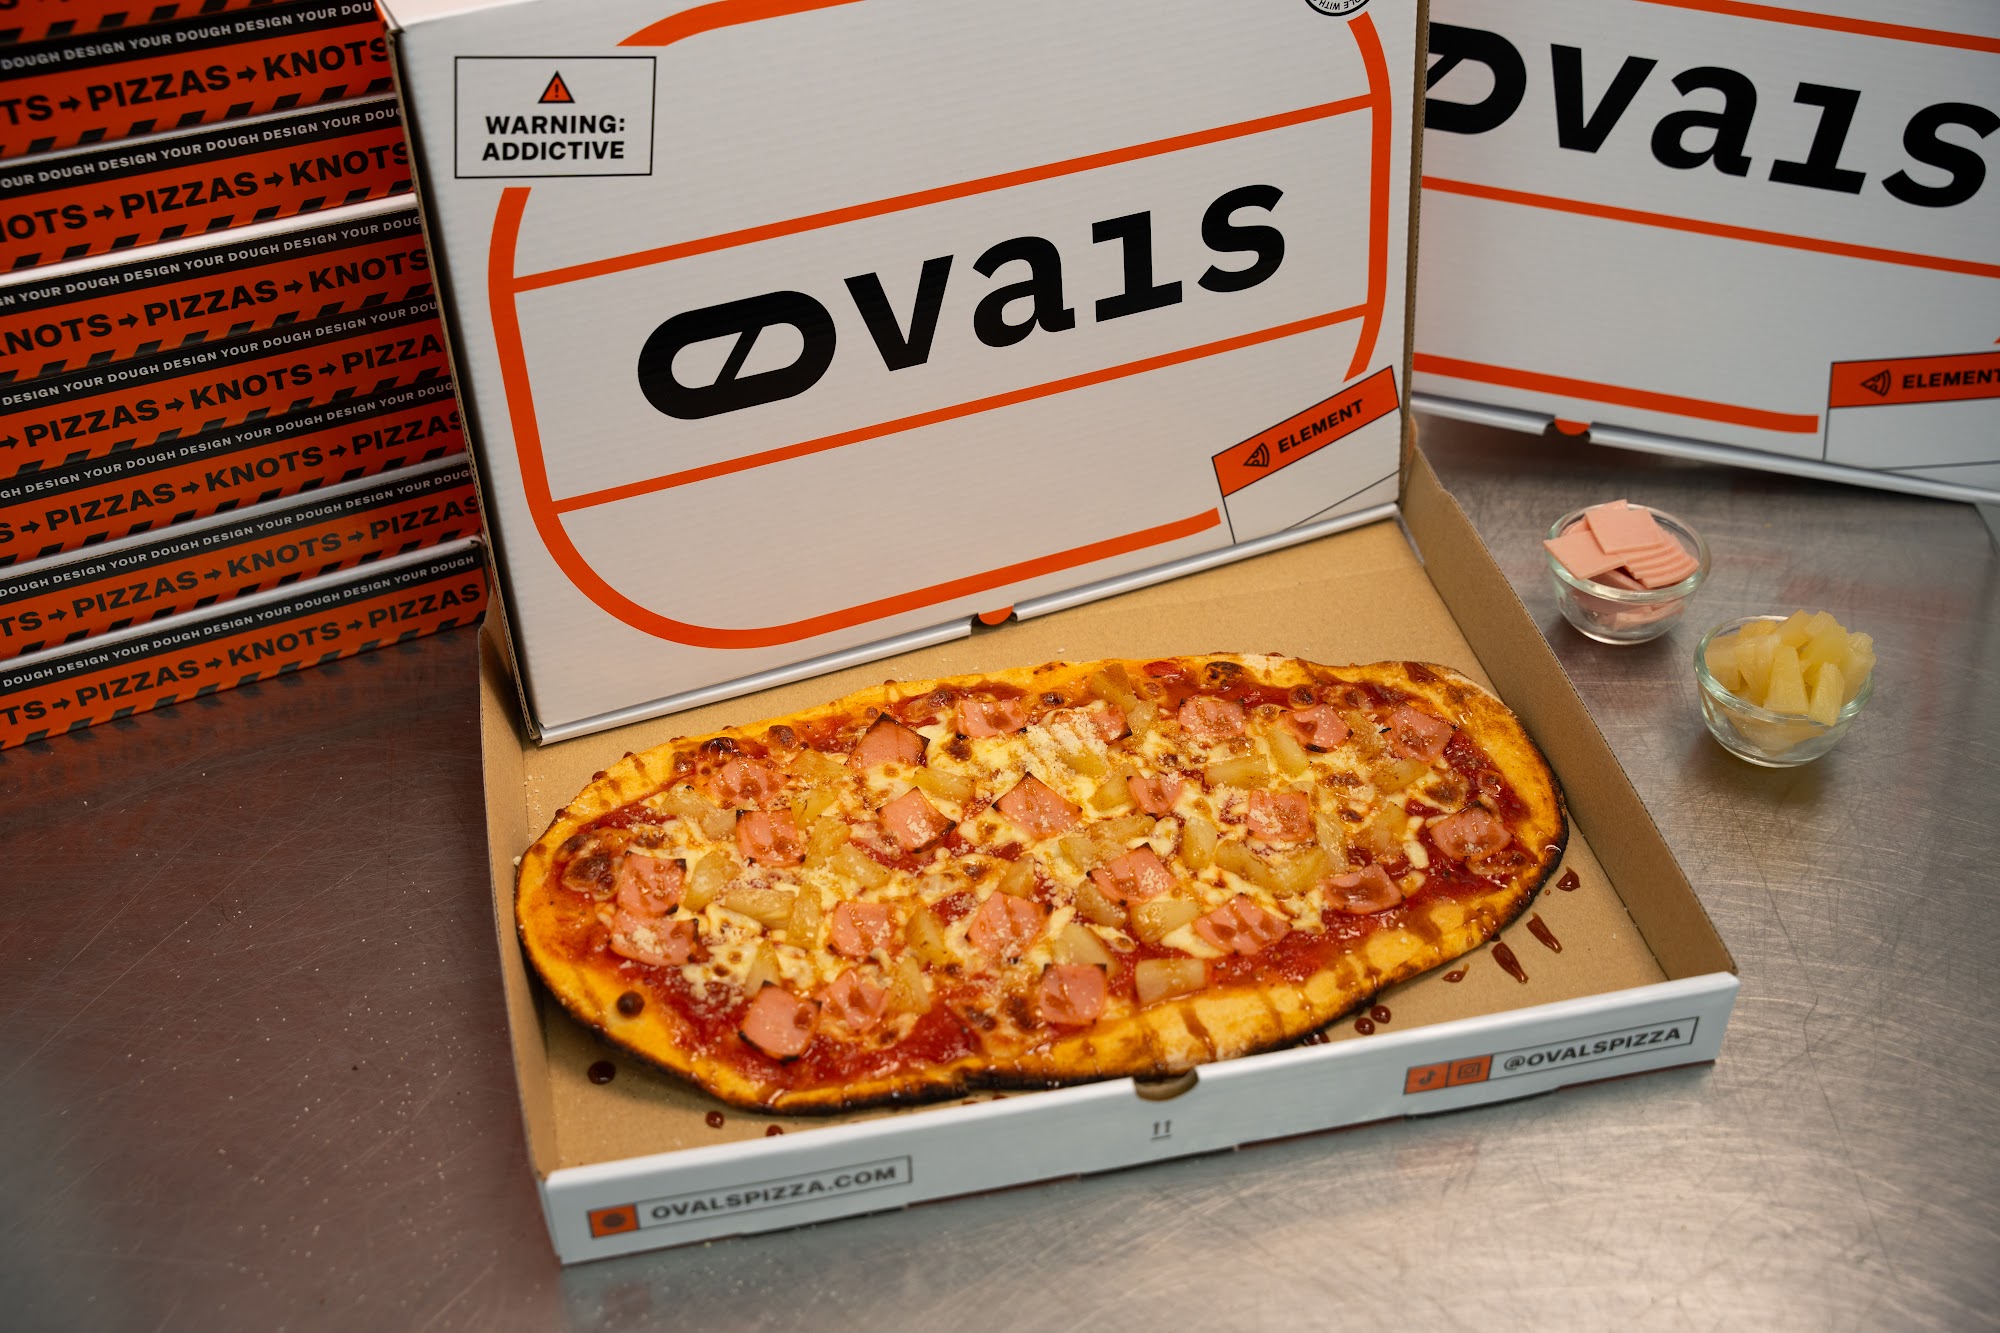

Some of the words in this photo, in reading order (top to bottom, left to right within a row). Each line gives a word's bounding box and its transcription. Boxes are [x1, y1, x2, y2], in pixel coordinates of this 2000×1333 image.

[1, 51, 60, 69] DOUGH
[63, 41, 125, 60] DESIGN
[128, 34, 172, 49] YOUR
[176, 24, 231, 42] DOUGH
[235, 14, 292, 32] DESIGN
[296, 7, 336, 22] YOUR
[341, 2, 376, 16] DOU
[86, 65, 230, 111] PIZZAS
[485, 114, 626, 135] WARNING:
[38, 163, 94, 181] DOUGH
[98, 152, 157, 171] DESIGN
[160, 144, 202, 159] YOUR
[206, 133, 258, 151] DOUGH
[262, 122, 317, 140] DESIGN
[322, 114, 360, 129] YOUR
[482, 140, 625, 161] ADDICTIVE
[0, 204, 87, 243] OTS
[120, 172, 258, 218] PIZZAS
[290, 141, 407, 186] KNOTS
[0, 314, 112, 356] NOTS
[144, 280, 278, 326] PIZZAS
[308, 248, 428, 292] KNOTS
[18, 286, 61, 301] YOUR
[65, 275, 120, 293] DOUGH
[123, 263, 180, 282] DESIGN
[184, 255, 224, 269] YOUR
[228, 244, 279, 261] DOUGH
[283, 232, 336, 250] DESIGN
[340, 224, 378, 239] YOUR
[2, 386, 59, 405] DESIGN
[62, 377, 103, 391] YOUR
[107, 364, 159, 382] DOUGH
[163, 351, 216, 370] DESIGN
[220, 342, 258, 357] YOUR
[262, 330, 311, 348] DOUGH
[315, 318, 366, 336] DESIGN
[370, 308, 406, 323] YOUR
[24, 399, 159, 447] PIZZAS
[190, 363, 312, 409] KNOTS
[342, 333, 443, 374] PIZZA
[25, 473, 79, 493] DESIGN
[83, 463, 122, 478] YOUR
[126, 450, 176, 469] DOUGH
[180, 437, 231, 456] DESIGN
[235, 427, 271, 442] YOUR
[276, 414, 322, 433] DOUGH
[326, 401, 375, 420] DESIGN
[379, 392, 414, 406] YOUR
[1277, 398, 1363, 453] ELEMENT
[45, 483, 175, 531] PIZZAS
[205, 446, 323, 492] KNOTS
[0, 578, 49, 597] DOUGH
[52, 564, 106, 583] DESIGN
[109, 554, 146, 568] YOUR
[150, 540, 199, 558] DOUGH
[202, 526, 253, 545] DESIGN
[256, 516, 292, 531] YOUR
[296, 503, 342, 521] DOUGH
[345, 490, 393, 508] DESIGN
[396, 480, 430, 494] YOUR
[72, 571, 198, 618] PIZZAS
[227, 532, 341, 577] KNOTS
[370, 495, 479, 539] PIZZAS
[3, 668, 53, 687] DOUGH
[56, 654, 108, 673] DESIGN
[112, 643, 148, 658] YOUR
[152, 630, 200, 648] DOUGH
[203, 616, 253, 635] DESIGN
[256, 606, 291, 620] YOUR
[294, 592, 340, 611] DOUGH
[343, 579, 390, 598] DESIGN
[394, 569, 427, 583] YOUR
[430, 556, 474, 574] DOUGH
[75, 659, 199, 706] PIZZAS
[228, 621, 340, 666] KNOTS
[368, 583, 480, 628] PIZZAS
[1504, 1027, 1681, 1071] @OVALSPIZZA
[651, 1166, 897, 1220] OVALSPIZZA.COM
